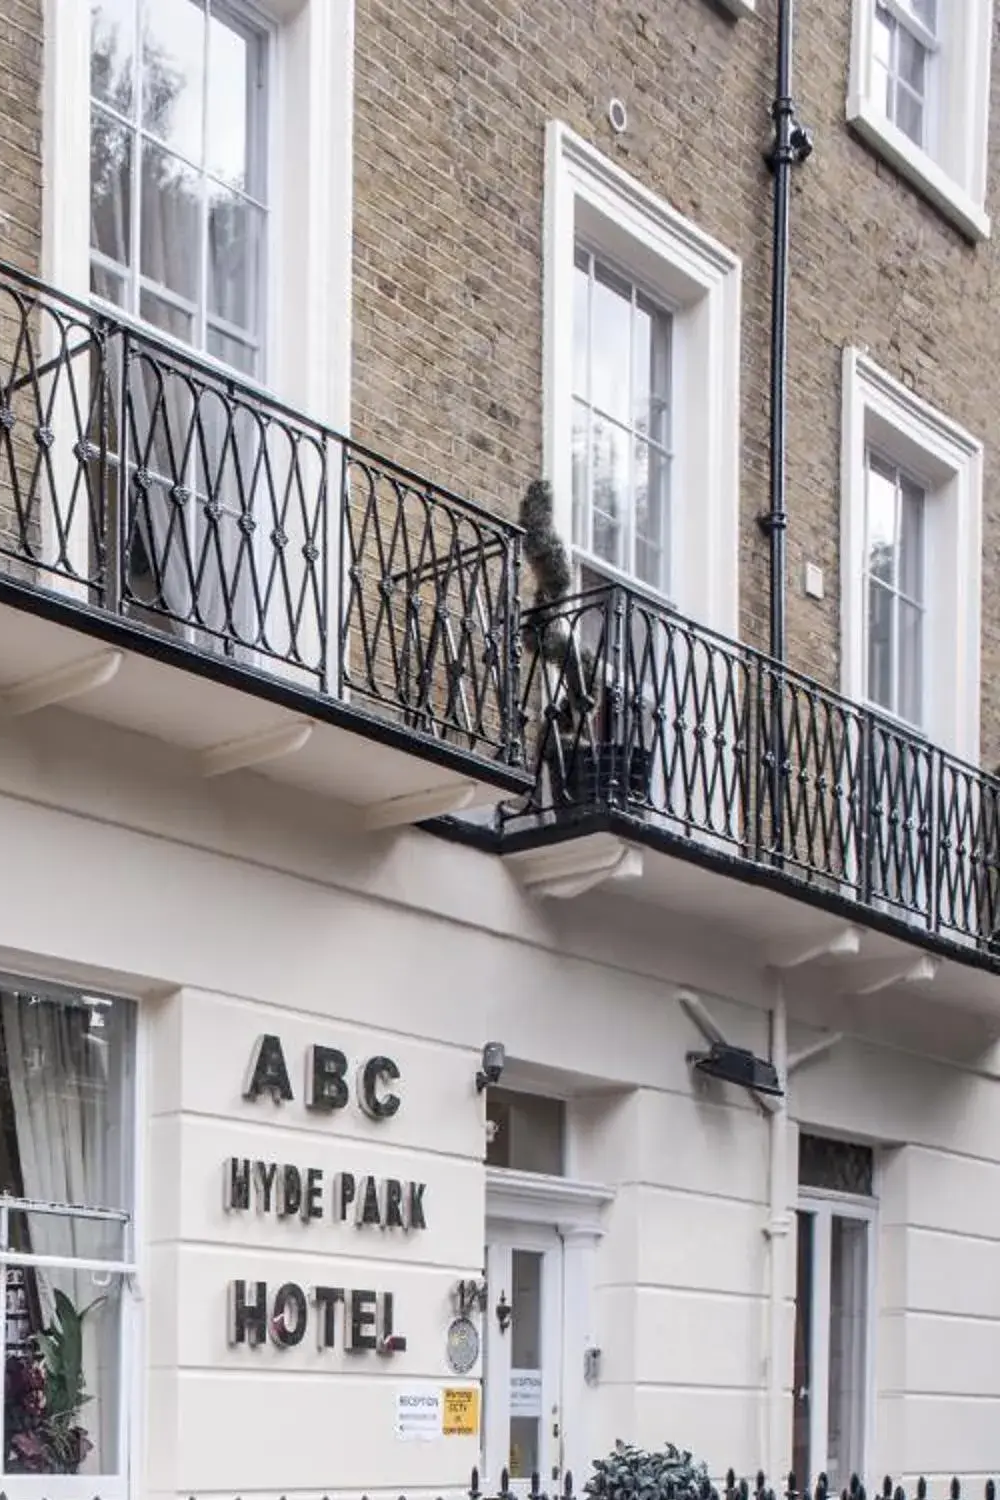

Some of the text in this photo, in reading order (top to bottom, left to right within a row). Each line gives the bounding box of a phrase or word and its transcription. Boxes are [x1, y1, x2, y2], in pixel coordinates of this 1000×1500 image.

[243, 1033, 400, 1119] ABC
[225, 1157, 427, 1229] HYDE PARK
[229, 1279, 407, 1353] HOTEL
